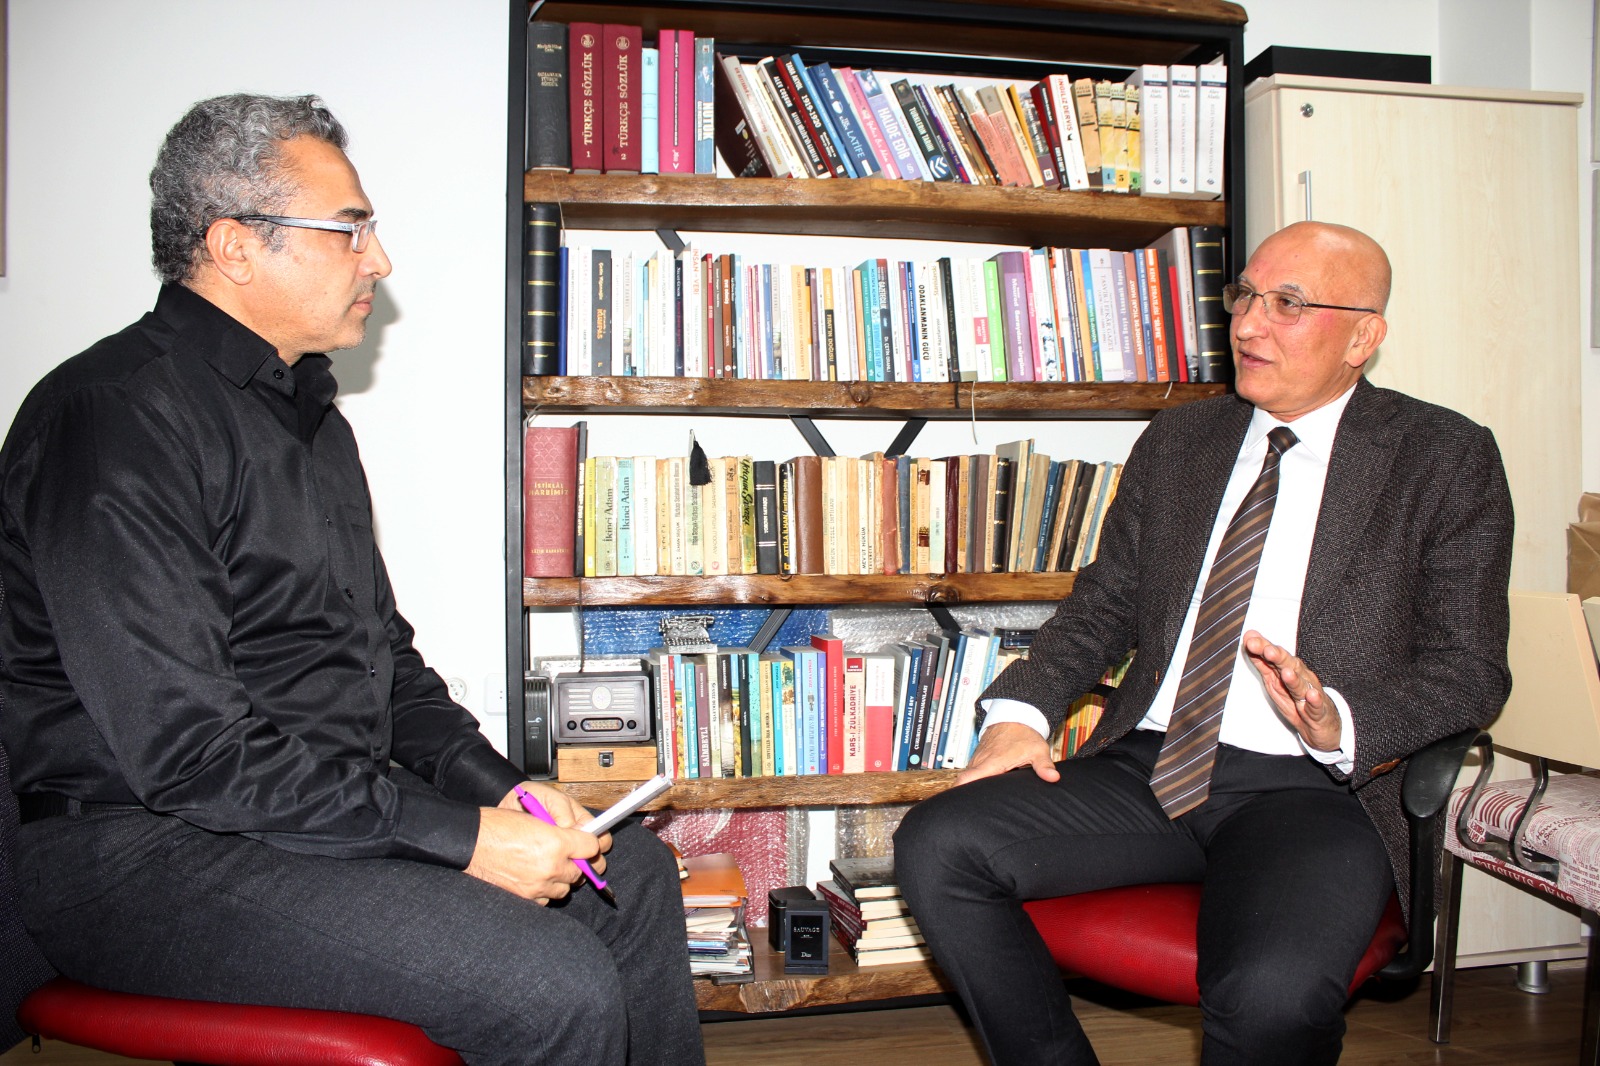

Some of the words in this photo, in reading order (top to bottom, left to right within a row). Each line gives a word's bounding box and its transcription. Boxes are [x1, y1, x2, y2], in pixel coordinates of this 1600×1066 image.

[581, 52, 593, 96] SÖZLÜK
[617, 54, 628, 98] SÖZLÜK
[786, 61, 797, 76] TAHA
[791, 74, 803, 91] AKYOL
[584, 99, 594, 146] TÜRKÇE
[619, 101, 630, 148] TÜRKÇE
[801, 94, 822, 128] 1919-1920
[908, 107, 927, 136] TÜRKLERİN
[846, 131, 866, 158] LATİFE
[877, 108, 902, 142] HALİDE
[892, 137, 911, 160] EDİB
[919, 284, 928, 340] ODAKLANMANIN
[1151, 285, 1160, 316] STRATEJİSİ
[922, 341, 931, 361] GÜCÜ
[1134, 319, 1143, 354] DARENDE'DE
[739, 458, 750, 495] Yorgun
[604, 488, 613, 515] Adam
[620, 505, 629, 530] İkinci
[741, 493, 753, 526] Savaşçı
[603, 516, 613, 542] İkinci
[917, 685, 928, 722] KAHRAMANLARI
[700, 727, 710, 767] SAİMBEYLİ
[1536, 823, 1552, 840] How
[1544, 827, 1557, 840] Sex
